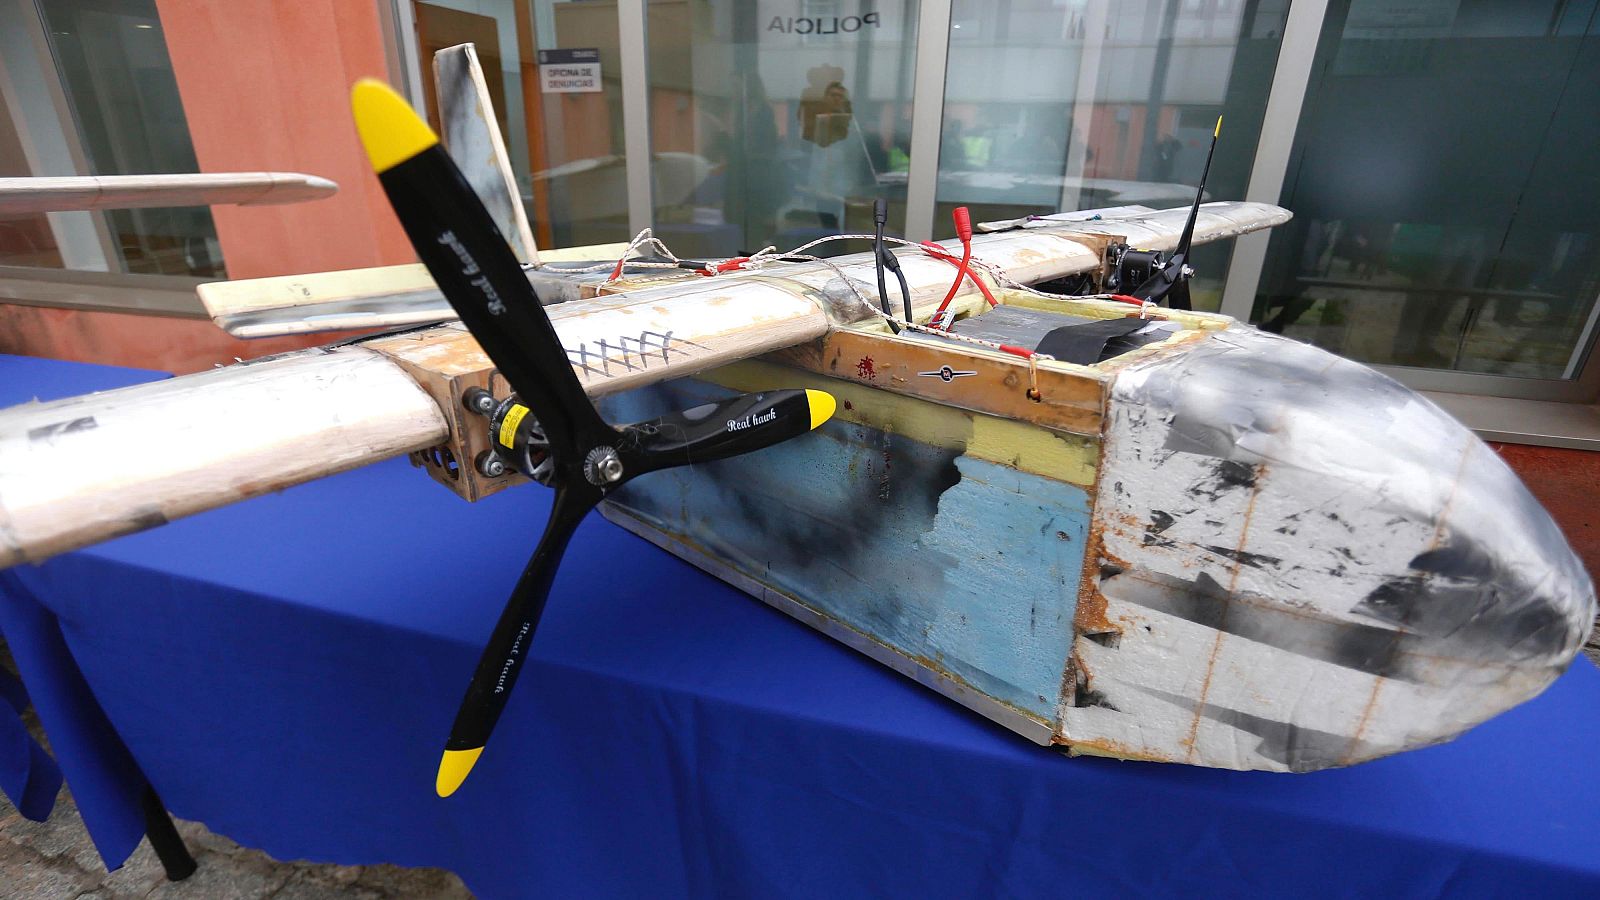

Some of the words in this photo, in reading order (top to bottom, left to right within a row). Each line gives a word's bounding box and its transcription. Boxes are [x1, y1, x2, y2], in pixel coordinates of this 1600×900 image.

[437, 230, 480, 275] hawk
[470, 275, 506, 316] Real
[727, 416, 751, 432] Real
[752, 407, 776, 426] hawk
[510, 622, 530, 655] Real
